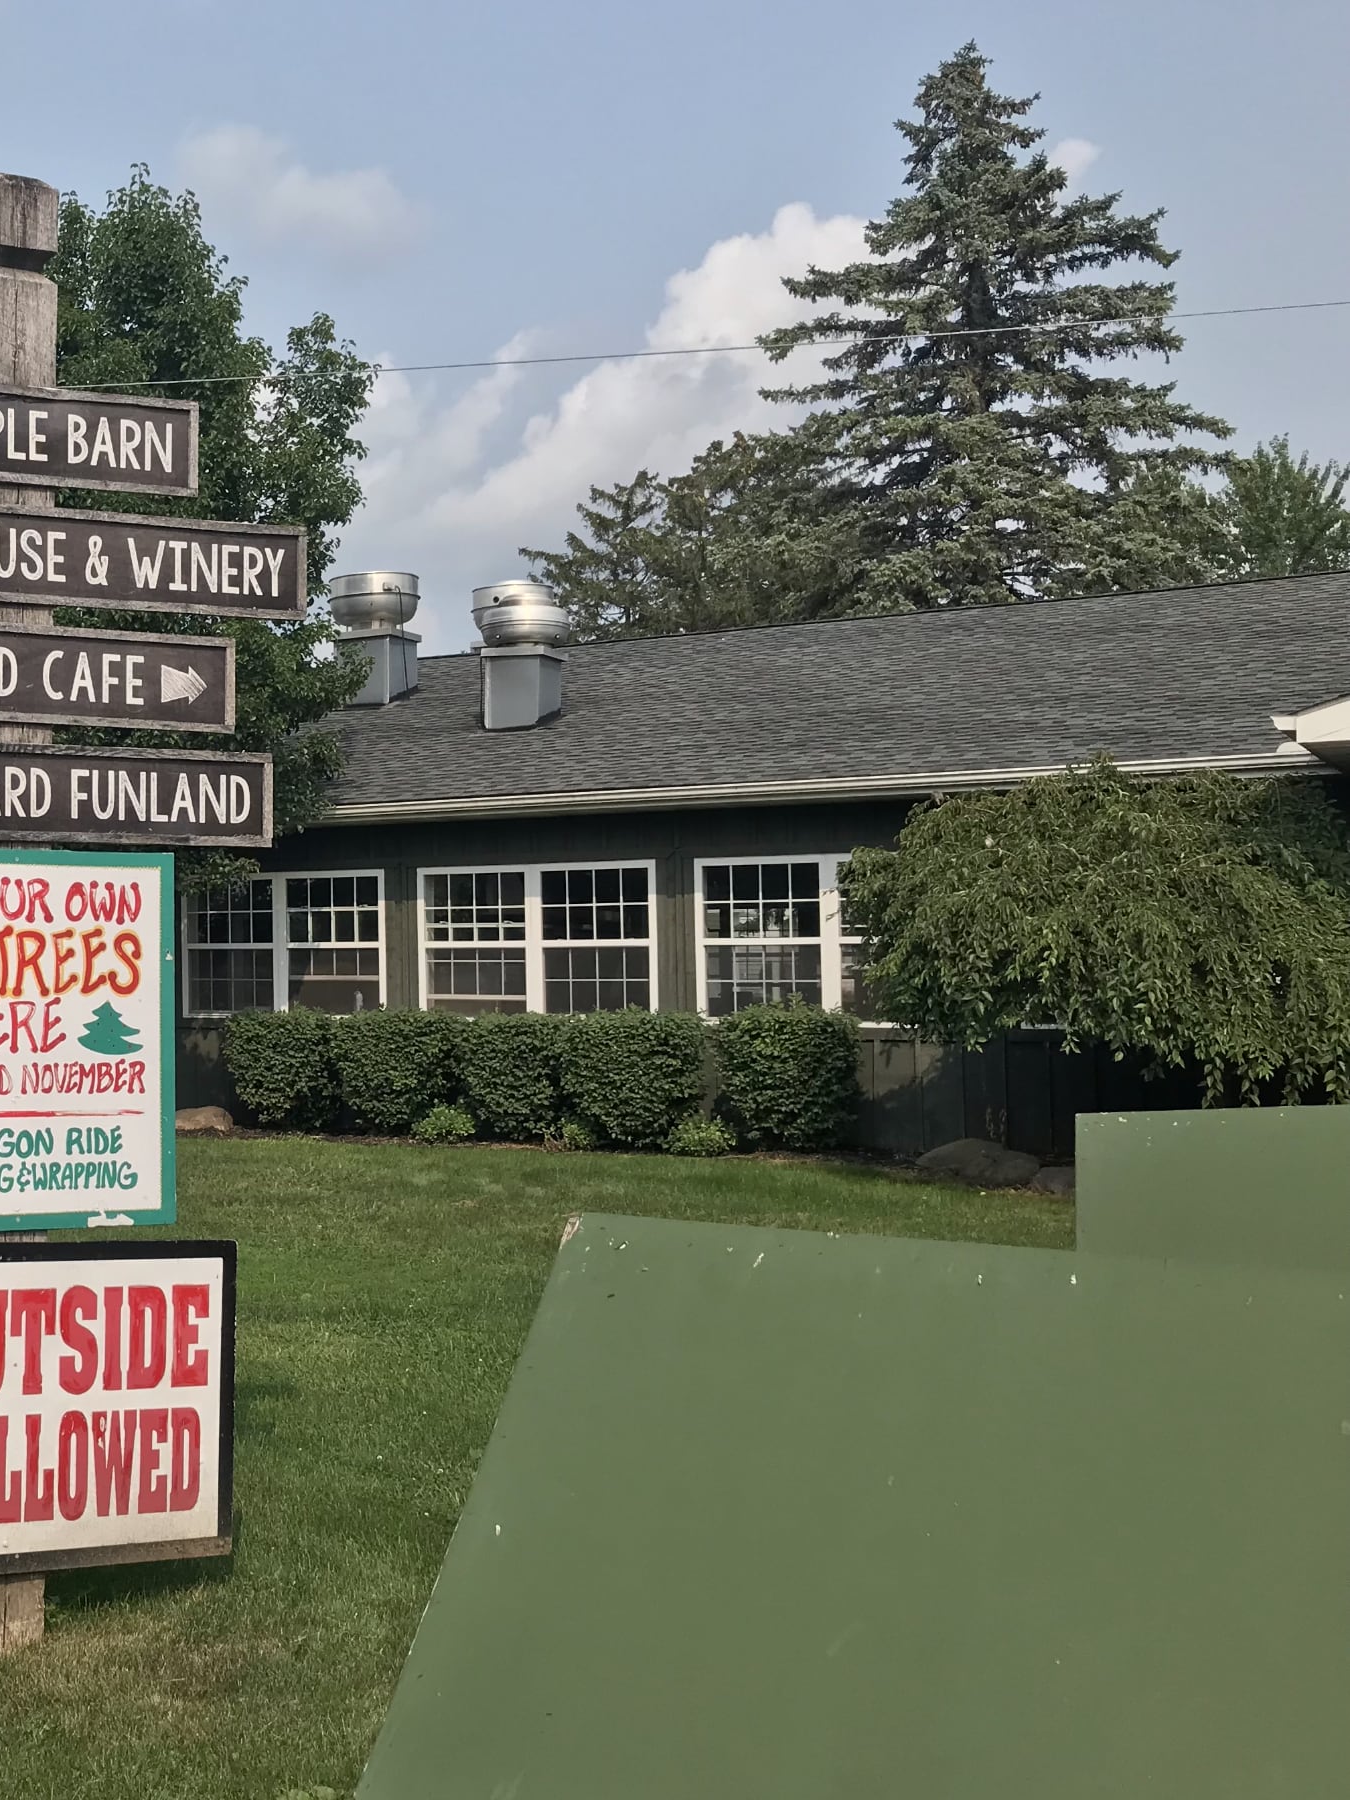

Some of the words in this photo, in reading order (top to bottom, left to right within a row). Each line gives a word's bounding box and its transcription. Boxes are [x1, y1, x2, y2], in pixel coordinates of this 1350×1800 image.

[66, 413, 173, 474] BARN
[85, 535, 109, 585] &
[128, 537, 285, 597] WINERY
[42, 650, 145, 706] CAFE
[70, 768, 251, 824] FUNLAND
[65, 879, 142, 925] OWN
[21, 1058, 146, 1095] NOVEMBER
[66, 1125, 123, 1155] RIDE
